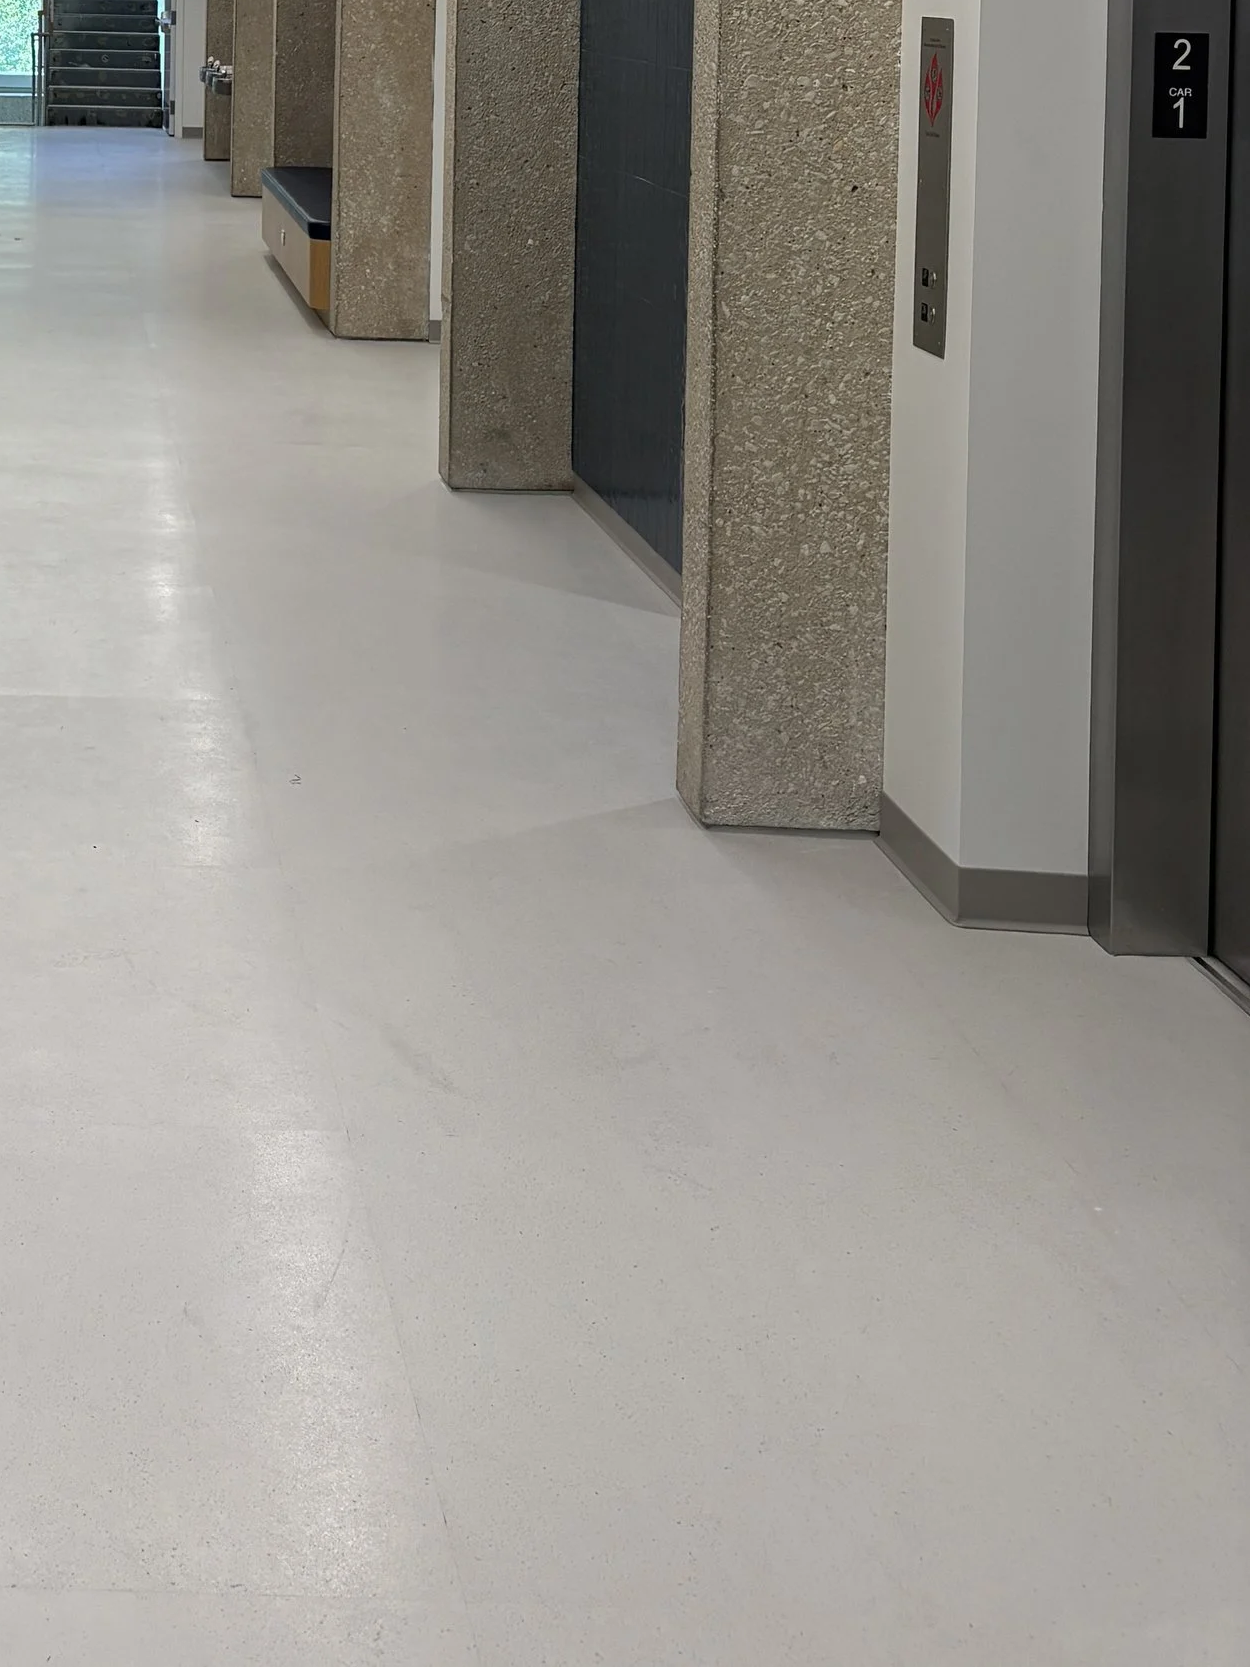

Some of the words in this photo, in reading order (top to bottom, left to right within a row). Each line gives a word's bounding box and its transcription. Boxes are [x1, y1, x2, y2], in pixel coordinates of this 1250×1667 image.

[1172, 38, 1191, 70] 2
[1168, 87, 1192, 97] CAR
[1172, 97, 1184, 129] 1
